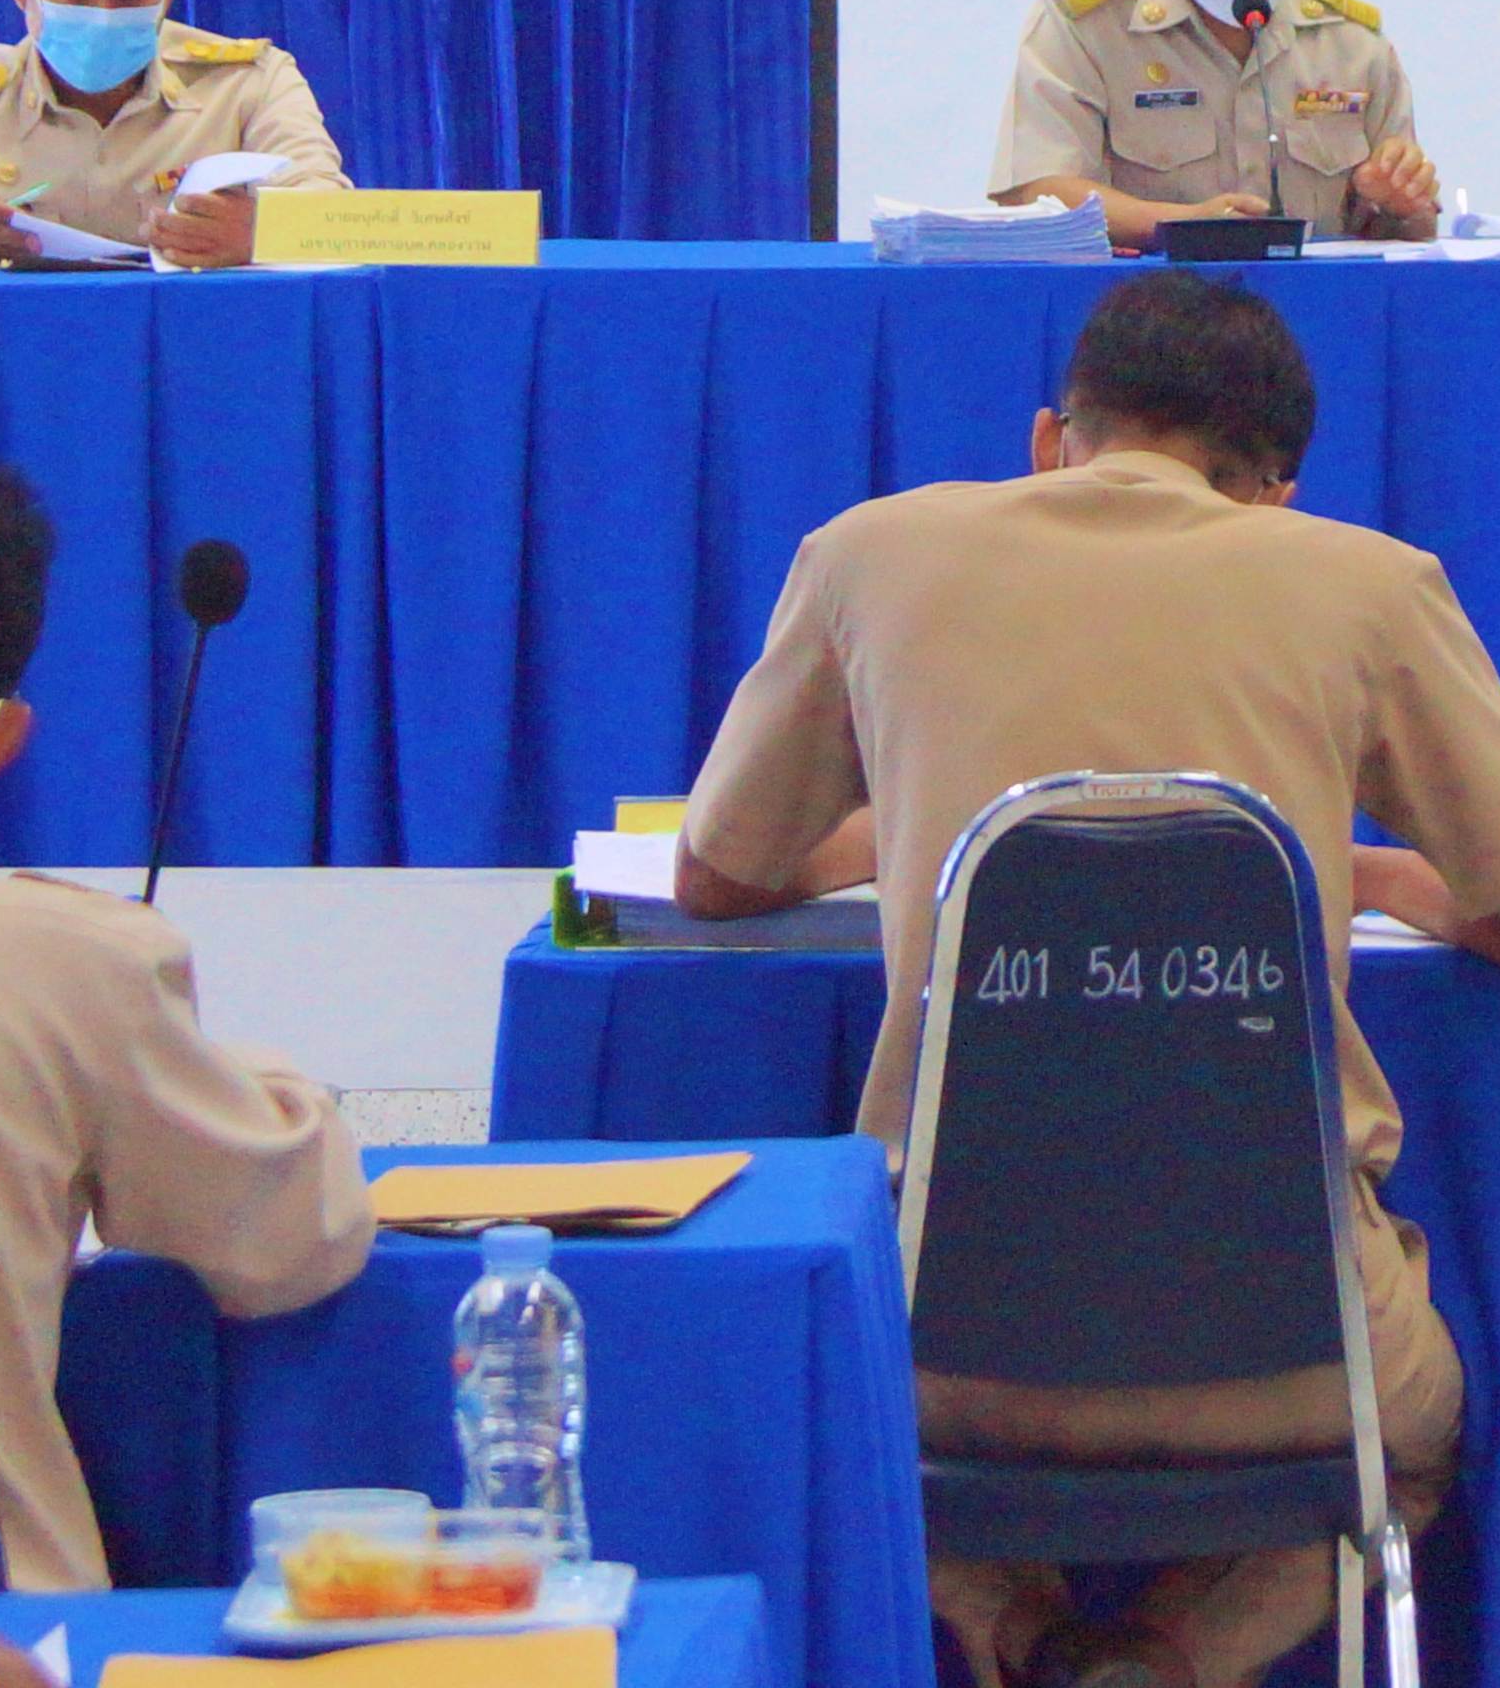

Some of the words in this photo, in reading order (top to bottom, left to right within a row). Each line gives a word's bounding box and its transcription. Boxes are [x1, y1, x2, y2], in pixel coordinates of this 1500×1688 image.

[978, 944, 1050, 1003] 401
[1084, 943, 1143, 1000] 54
[1161, 944, 1285, 1001] 0346
